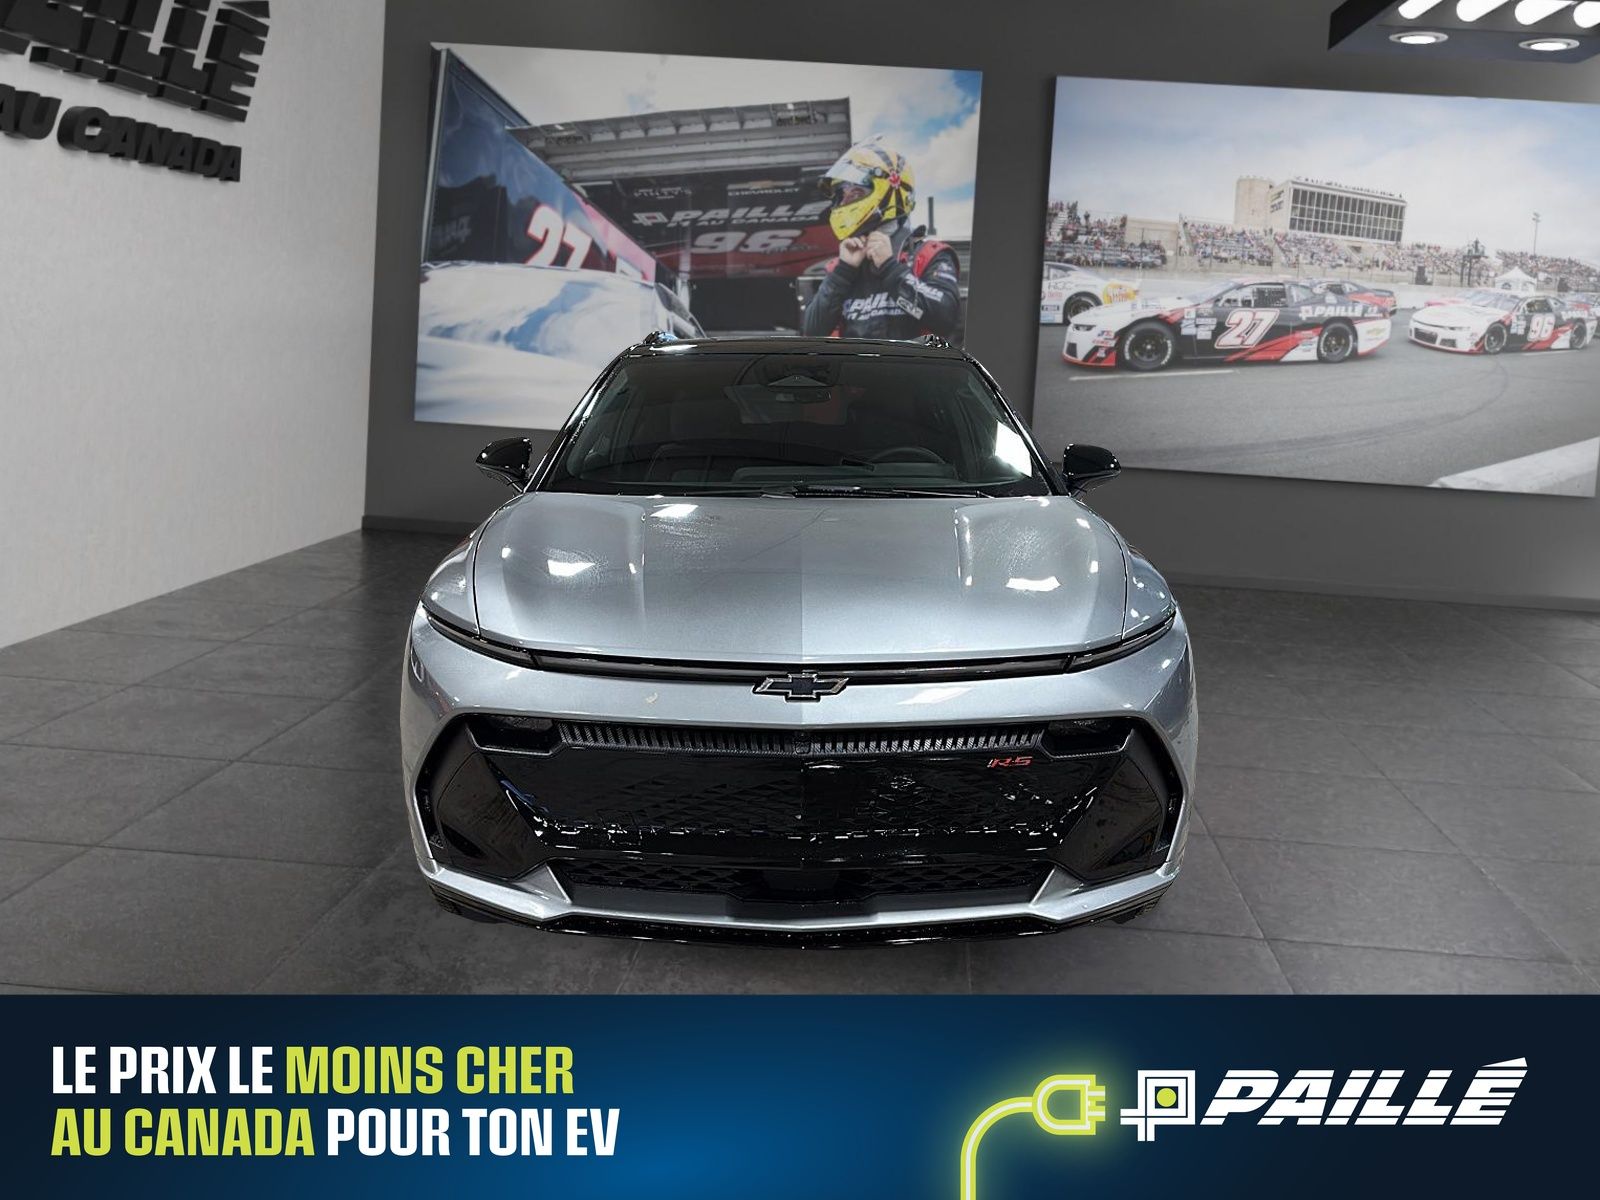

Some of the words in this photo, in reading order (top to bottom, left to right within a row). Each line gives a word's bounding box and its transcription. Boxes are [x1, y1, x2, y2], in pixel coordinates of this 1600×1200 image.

[57, 105, 242, 182] CANADA
[525, 203, 593, 271] 27
[690, 229, 803, 254] 96
[1214, 308, 1281, 349] 27
[1527, 313, 1556, 342] 96
[986, 756, 1034, 768] RS
